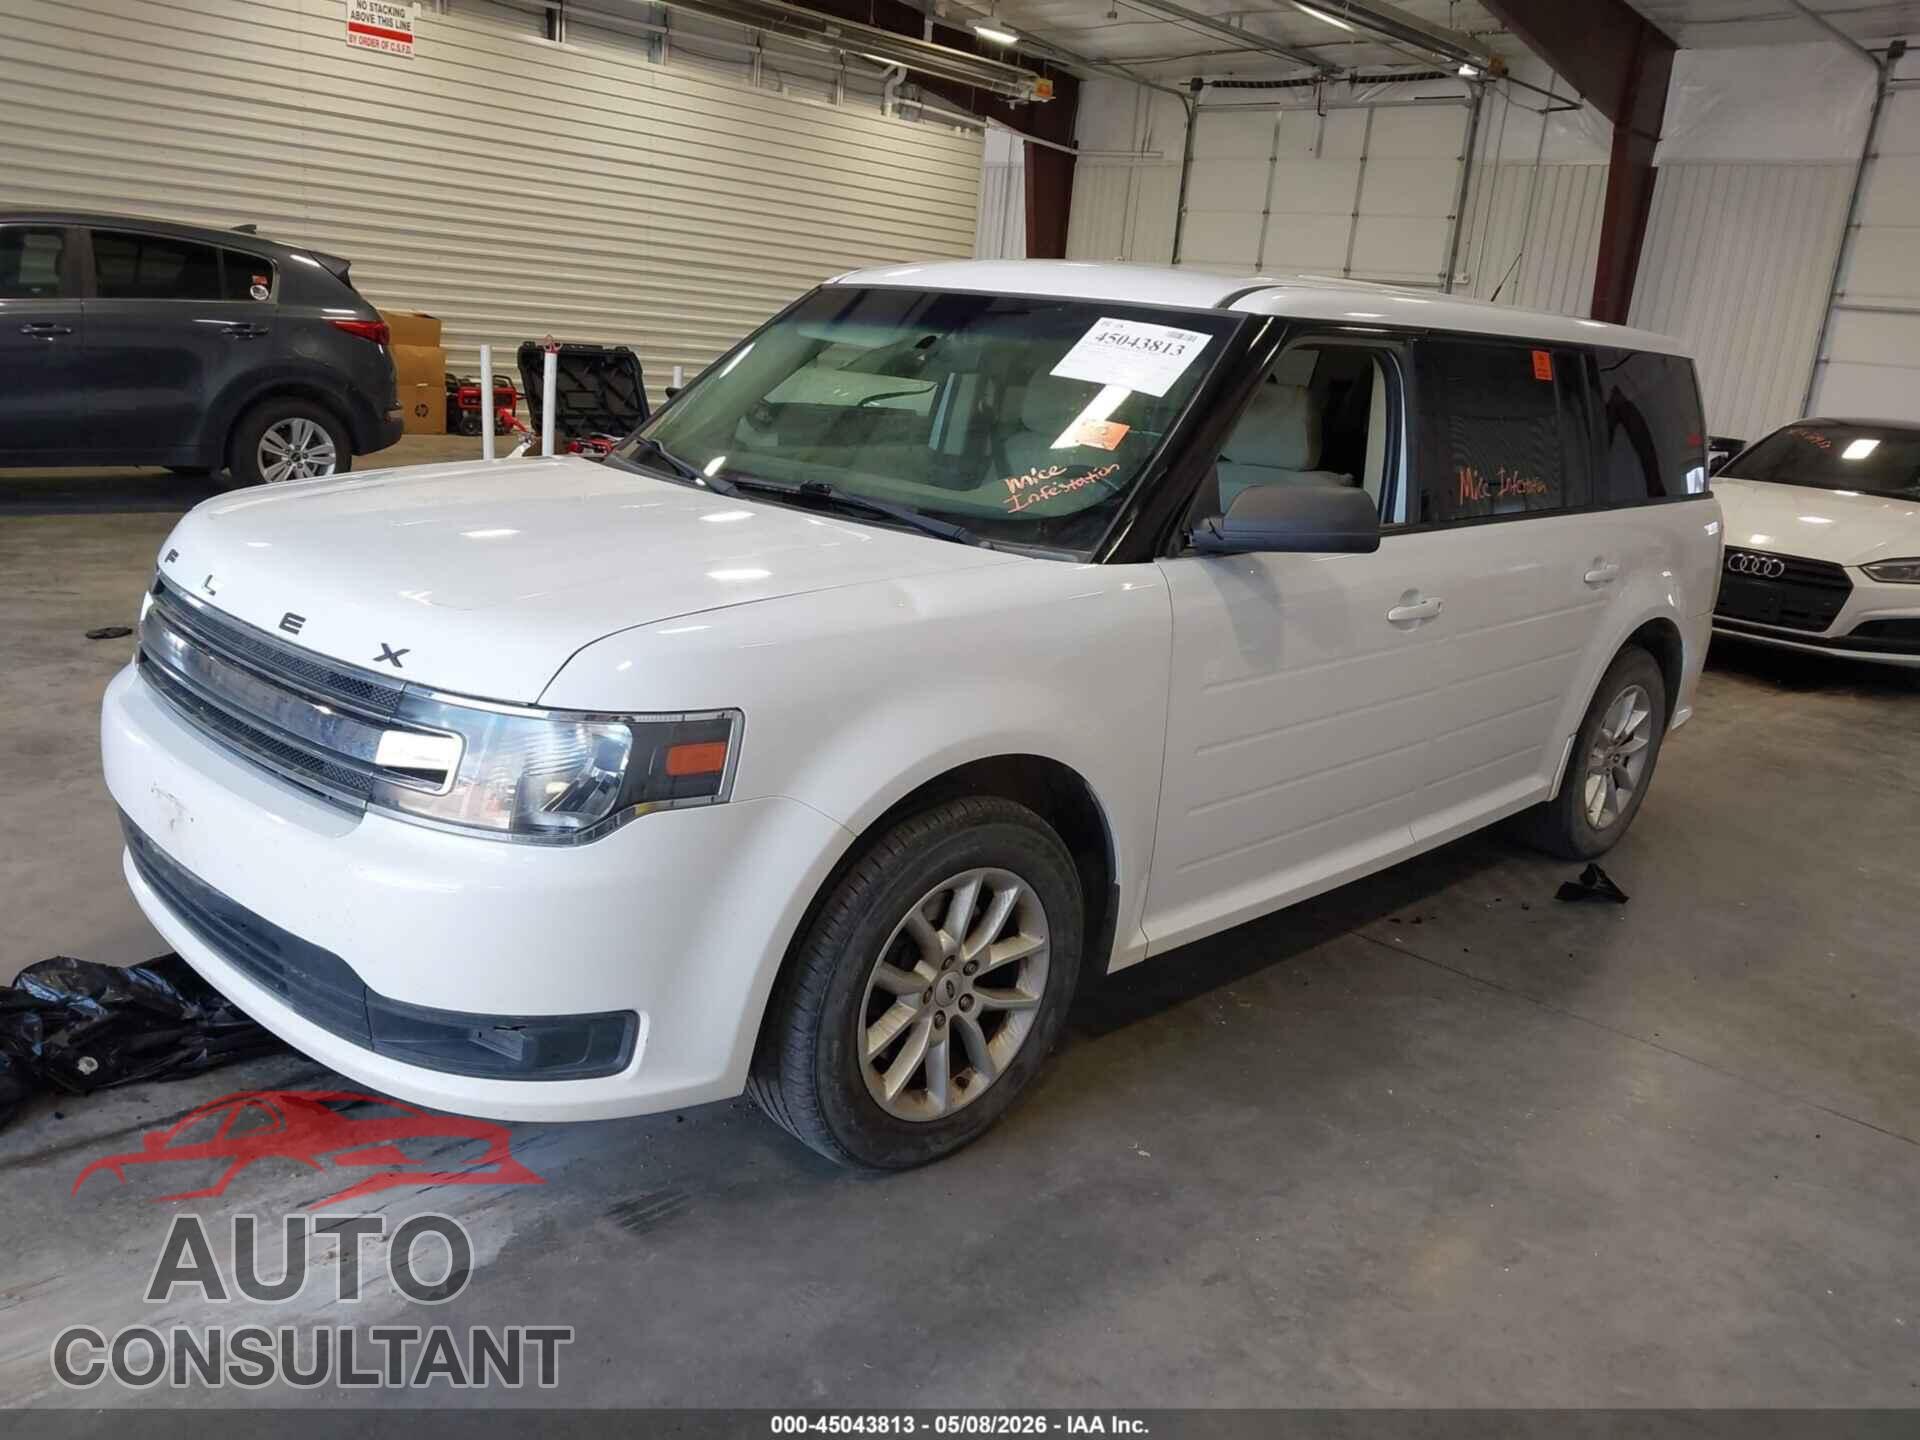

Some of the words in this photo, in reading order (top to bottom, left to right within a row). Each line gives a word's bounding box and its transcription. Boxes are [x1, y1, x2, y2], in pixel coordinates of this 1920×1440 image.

[356, 0, 367, 10] NO
[369, 2, 405, 18] STACKING
[351, 10, 375, 24] ABOVE
[378, 15, 393, 28] THIS
[395, 19, 411, 31] LINE
[349, 34, 357, 44] BY
[359, 35, 379, 49] ORDER
[381, 40, 389, 50] OF
[1096, 332, 1186, 356] 45043813
[164, 548, 411, 668] FLEX
